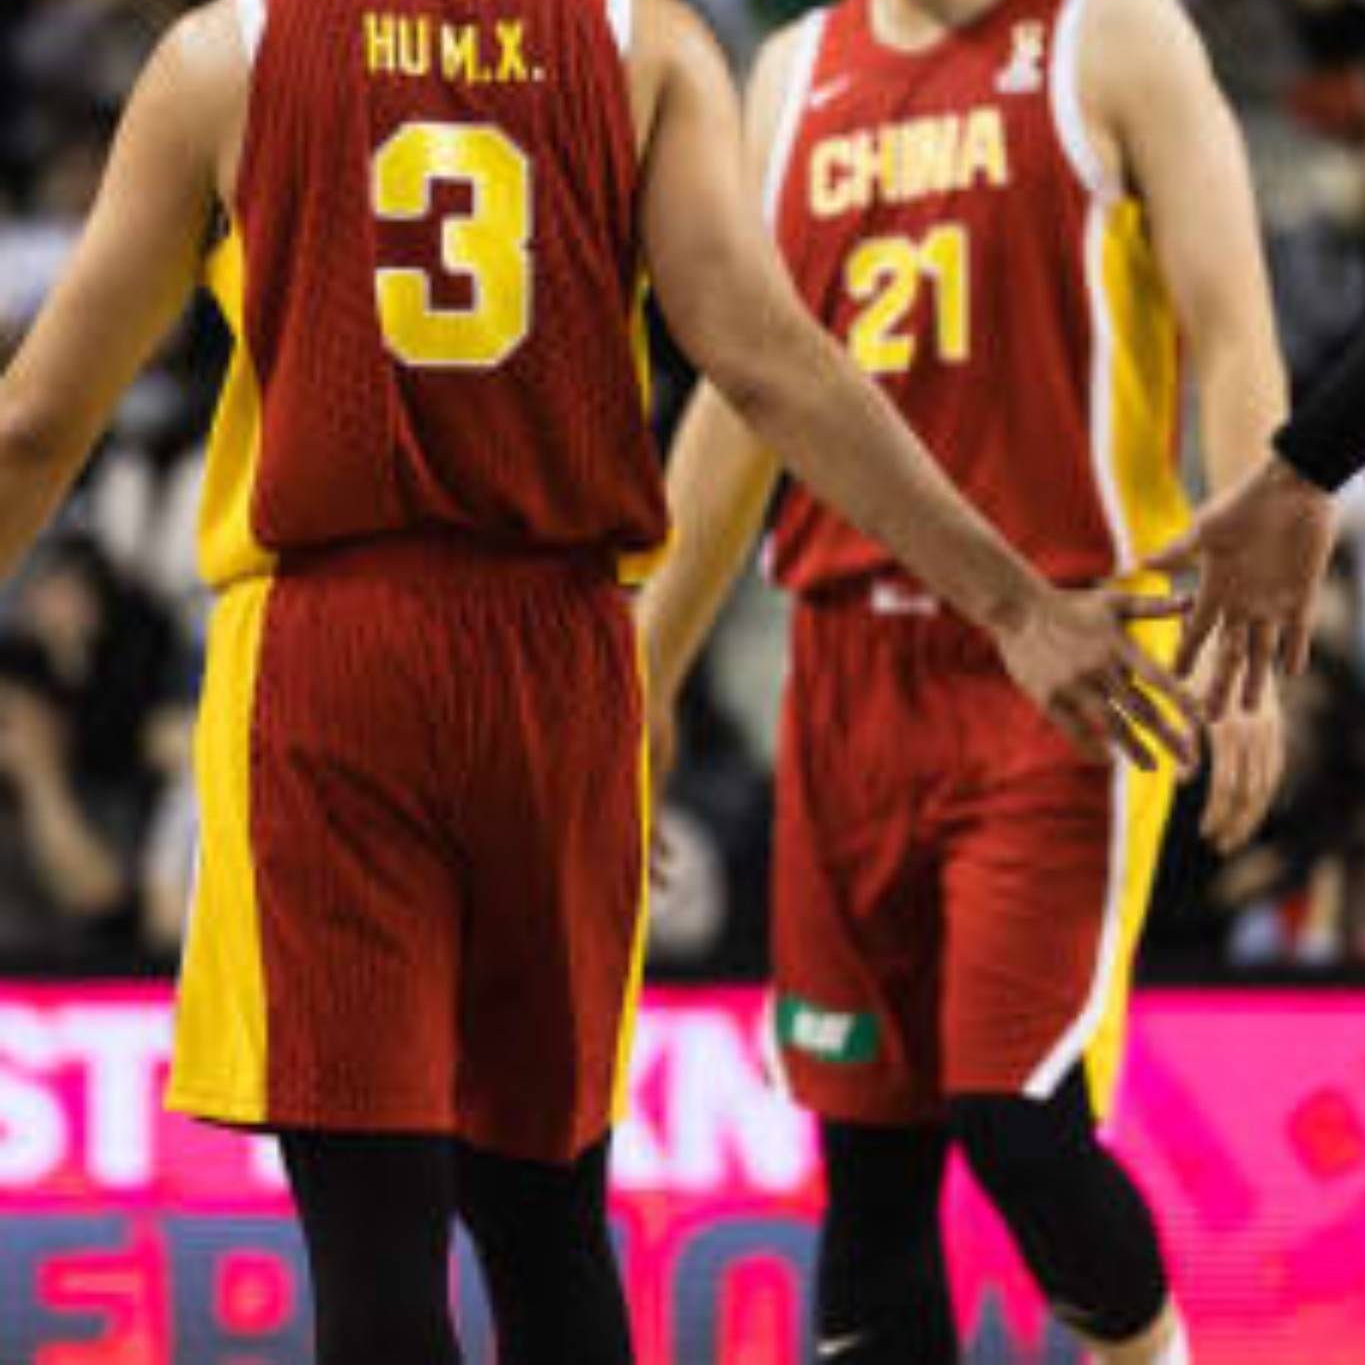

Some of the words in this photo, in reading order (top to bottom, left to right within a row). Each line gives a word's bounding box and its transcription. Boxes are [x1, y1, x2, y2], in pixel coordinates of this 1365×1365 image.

[364, 11, 431, 76] HU
[809, 105, 1007, 218] CHINA
[370, 121, 534, 367] 3
[846, 222, 970, 373] 21
